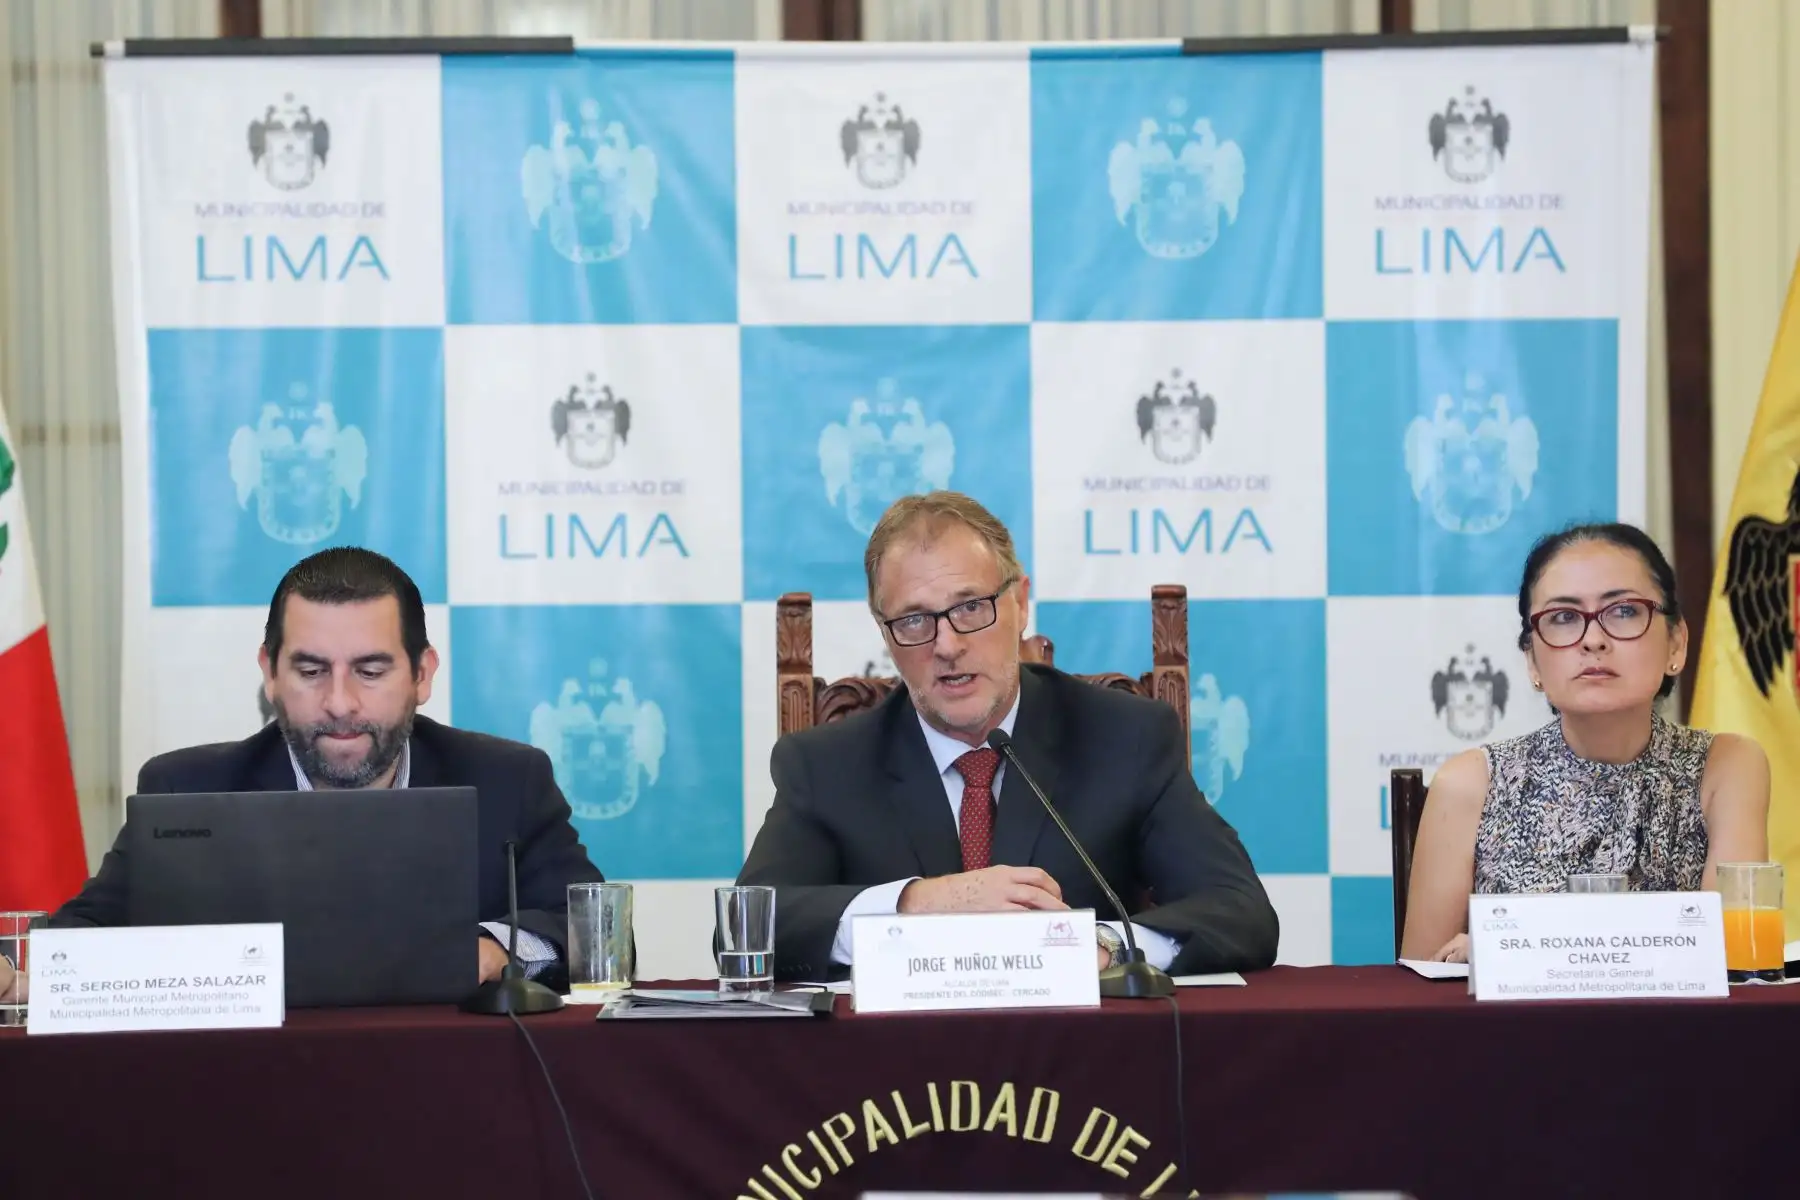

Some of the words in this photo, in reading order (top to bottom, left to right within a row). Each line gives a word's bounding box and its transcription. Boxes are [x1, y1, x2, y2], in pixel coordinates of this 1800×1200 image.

[194, 201, 357, 218] MUNICIPALIDAD
[361, 201, 385, 218] DE
[787, 201, 946, 216] MUNICIPALIDAD
[951, 201, 973, 216] DE
[1375, 194, 1533, 211] MUNICIPALIDAD
[1539, 193, 1564, 210] DE
[196, 234, 390, 282] LIMA
[788, 233, 979, 280] LIMA
[1375, 226, 1566, 274] LIMA
[499, 479, 657, 496] MUNICIPALIDAD
[660, 479, 685, 496] DE
[1083, 475, 1241, 492] MUNICIPALIDAD
[1245, 475, 1270, 491] DE
[498, 512, 691, 560] LIMA
[1083, 507, 1274, 556] LIMA
[153, 826, 212, 839] Lenovo
[1499, 938, 1536, 950] SRA.
[1540, 937, 1607, 949] ROXANA
[1611, 933, 1697, 948] CALDERÓN
[908, 957, 946, 976] JORGE
[954, 952, 999, 972] MUÑOZ
[1003, 954, 1044, 970] WELLS
[1568, 952, 1631, 965] CHAVEZ
[1609, 967, 1654, 978] General
[50, 983, 75, 994] SR.
[80, 979, 140, 993] SERGIO
[144, 977, 189, 989] MEZA
[192, 974, 267, 988] SALAZAR
[1498, 983, 1576, 995] Municipalidad
[1579, 982, 1656, 995] Metropolitana
[1660, 981, 1675, 991] de
[1678, 981, 1706, 991] Lima
[62, 995, 110, 1007] Gerente
[113, 993, 167, 1005] Municipal
[171, 990, 249, 1003] Metropolitano
[50, 1008, 130, 1021] Municipalidad
[133, 1005, 212, 1019] Metropolitana
[214, 1004, 230, 1015] de
[232, 1003, 261, 1014] Lima
[1071, 1106, 1152, 1178] DE
